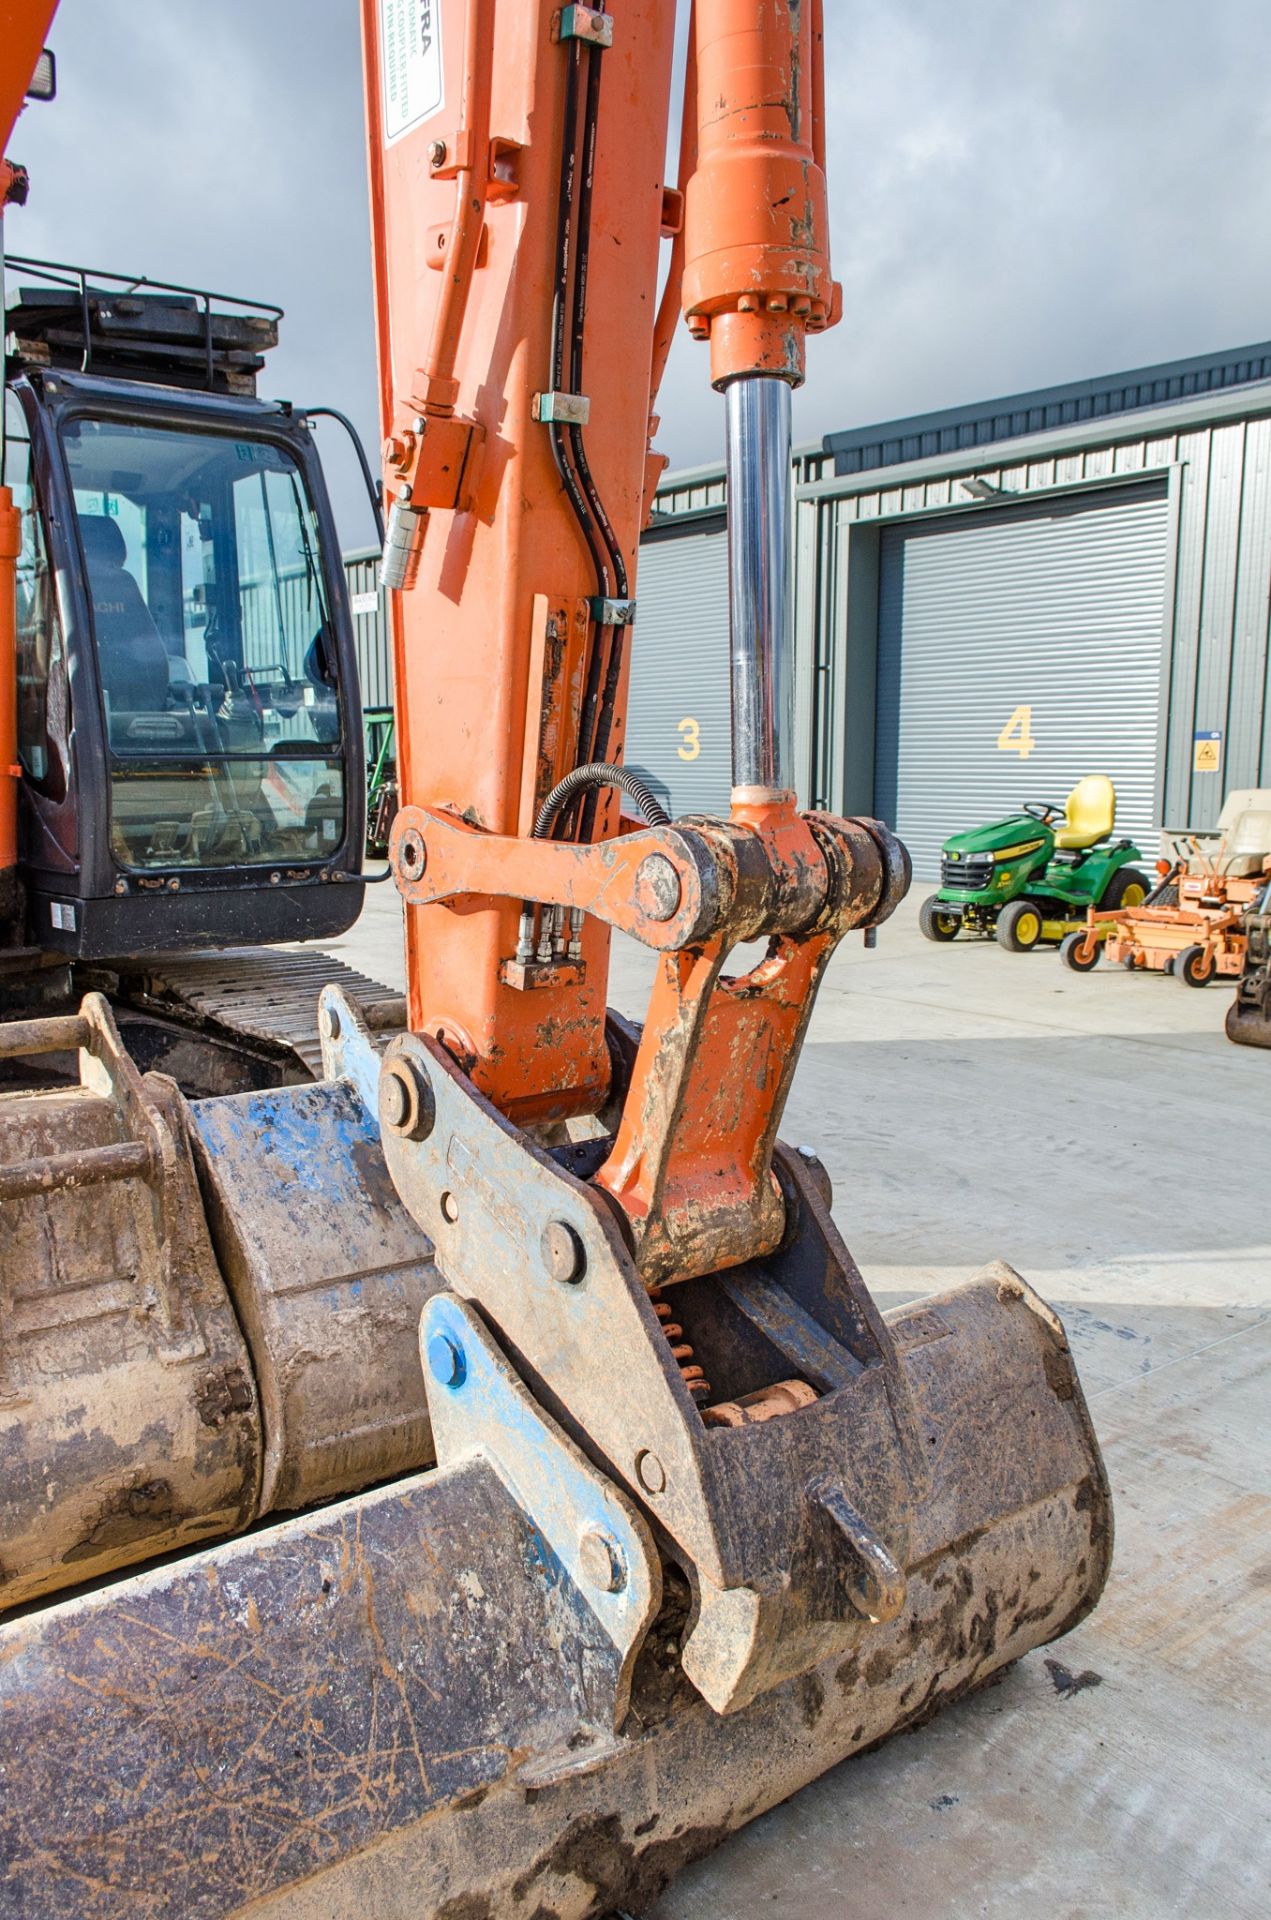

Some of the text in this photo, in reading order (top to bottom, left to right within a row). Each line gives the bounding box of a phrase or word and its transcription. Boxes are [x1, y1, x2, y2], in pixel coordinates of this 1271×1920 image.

[386, 4, 397, 102] PIN REQUIRED
[397, 10, 407, 71] COUPLER
[400, 73, 409, 118] FITTED
[677, 716, 701, 761] 3
[997, 705, 1035, 759] 4
